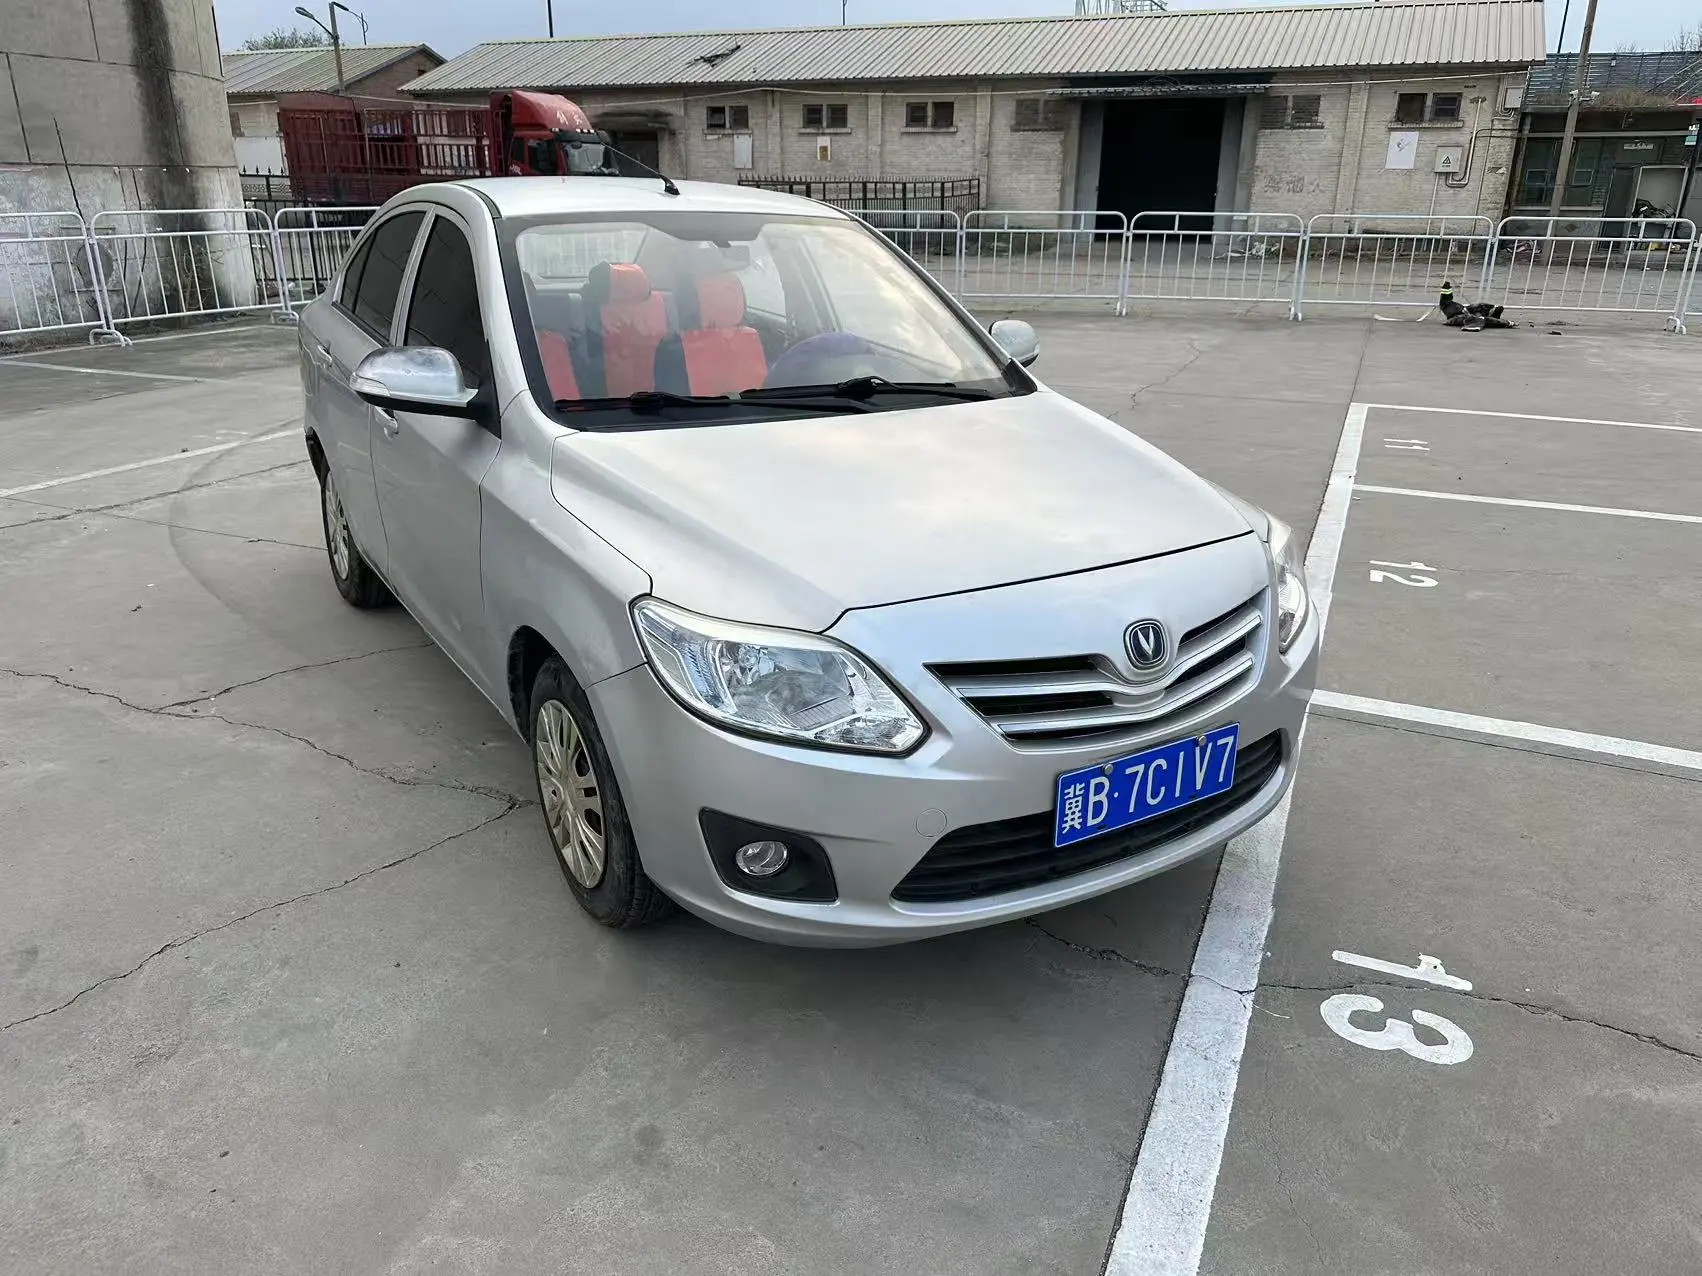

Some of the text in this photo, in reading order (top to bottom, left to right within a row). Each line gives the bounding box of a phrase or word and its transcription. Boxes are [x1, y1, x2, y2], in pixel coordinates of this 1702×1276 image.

[1383, 438, 1431, 451] 11
[1369, 560, 1440, 588] 12
[1319, 949, 1475, 1066] 13
